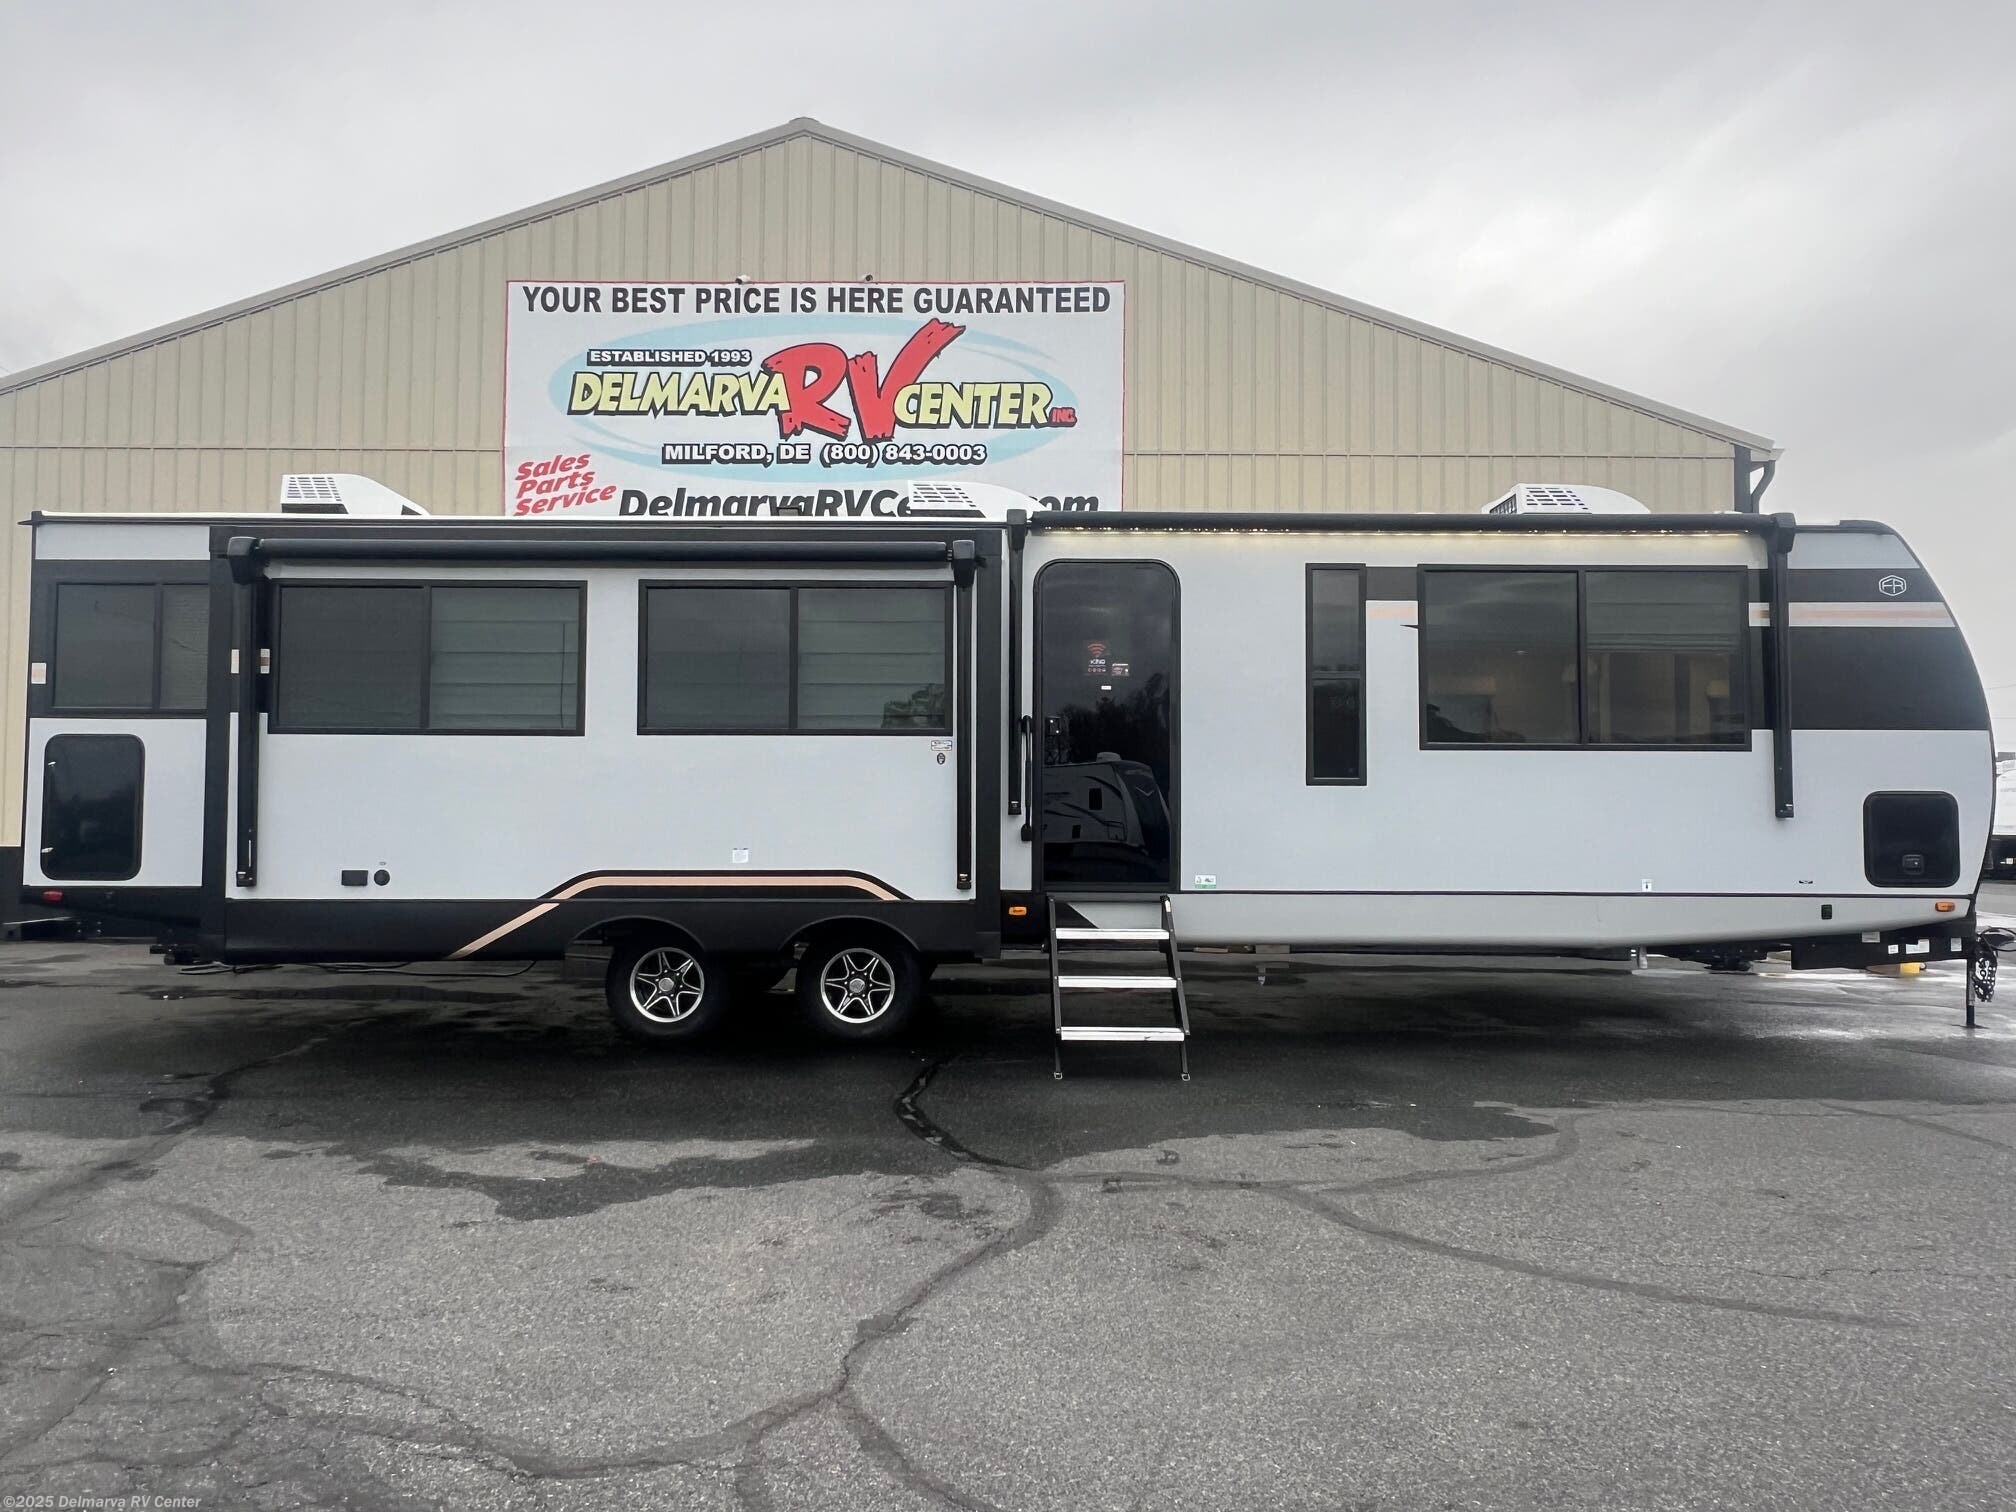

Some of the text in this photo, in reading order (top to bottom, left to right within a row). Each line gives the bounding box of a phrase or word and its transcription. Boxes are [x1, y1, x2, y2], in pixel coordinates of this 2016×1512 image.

[523, 286, 1111, 314] YOUR BEST PRICE IS HERE GUARANTEED
[587, 349, 752, 366] ESTABLISHED 1993
[568, 371, 791, 419] DELMARVA
[761, 317, 966, 442] RV
[892, 381, 1053, 430] CENTER
[515, 453, 591, 481] Sales
[662, 443, 988, 469] MILFORD, DE (800) 843-0003
[515, 469, 596, 499] Parts
[513, 485, 617, 516] Service
